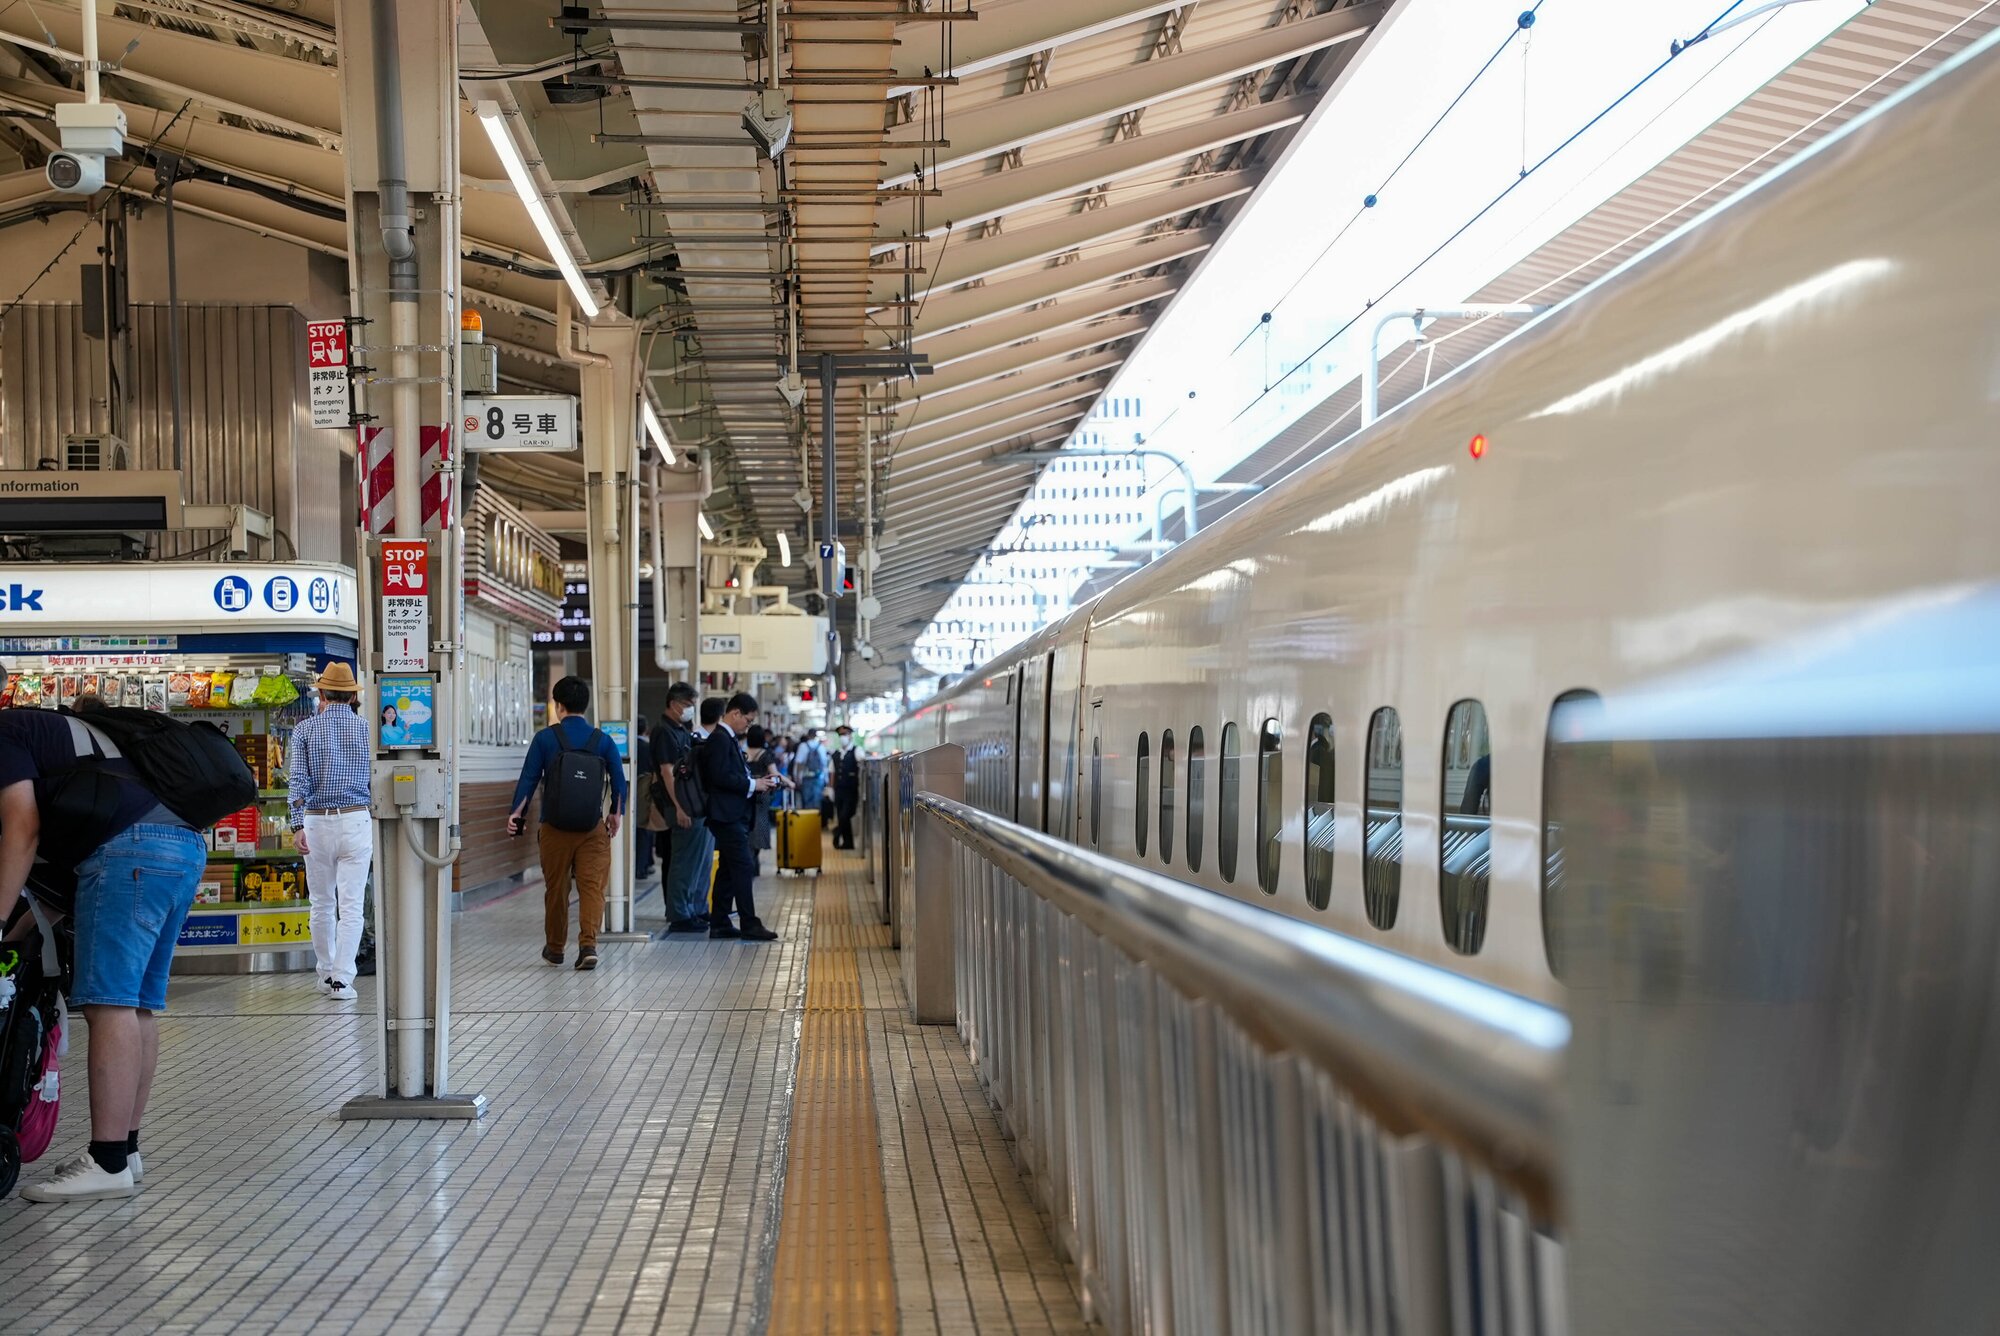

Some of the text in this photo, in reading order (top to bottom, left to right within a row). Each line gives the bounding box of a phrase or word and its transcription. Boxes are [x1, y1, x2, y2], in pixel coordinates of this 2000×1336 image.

[309, 325, 344, 338] STOP
[313, 370, 344, 381] 非常停止
[314, 385, 345, 395] ボタン
[487, 406, 558, 440] 8号車
[385, 549, 425, 561] STOP
[822, 545, 831, 557] 7
[388, 599, 422, 607] 非常停止
[388, 609, 422, 618] ボタン
